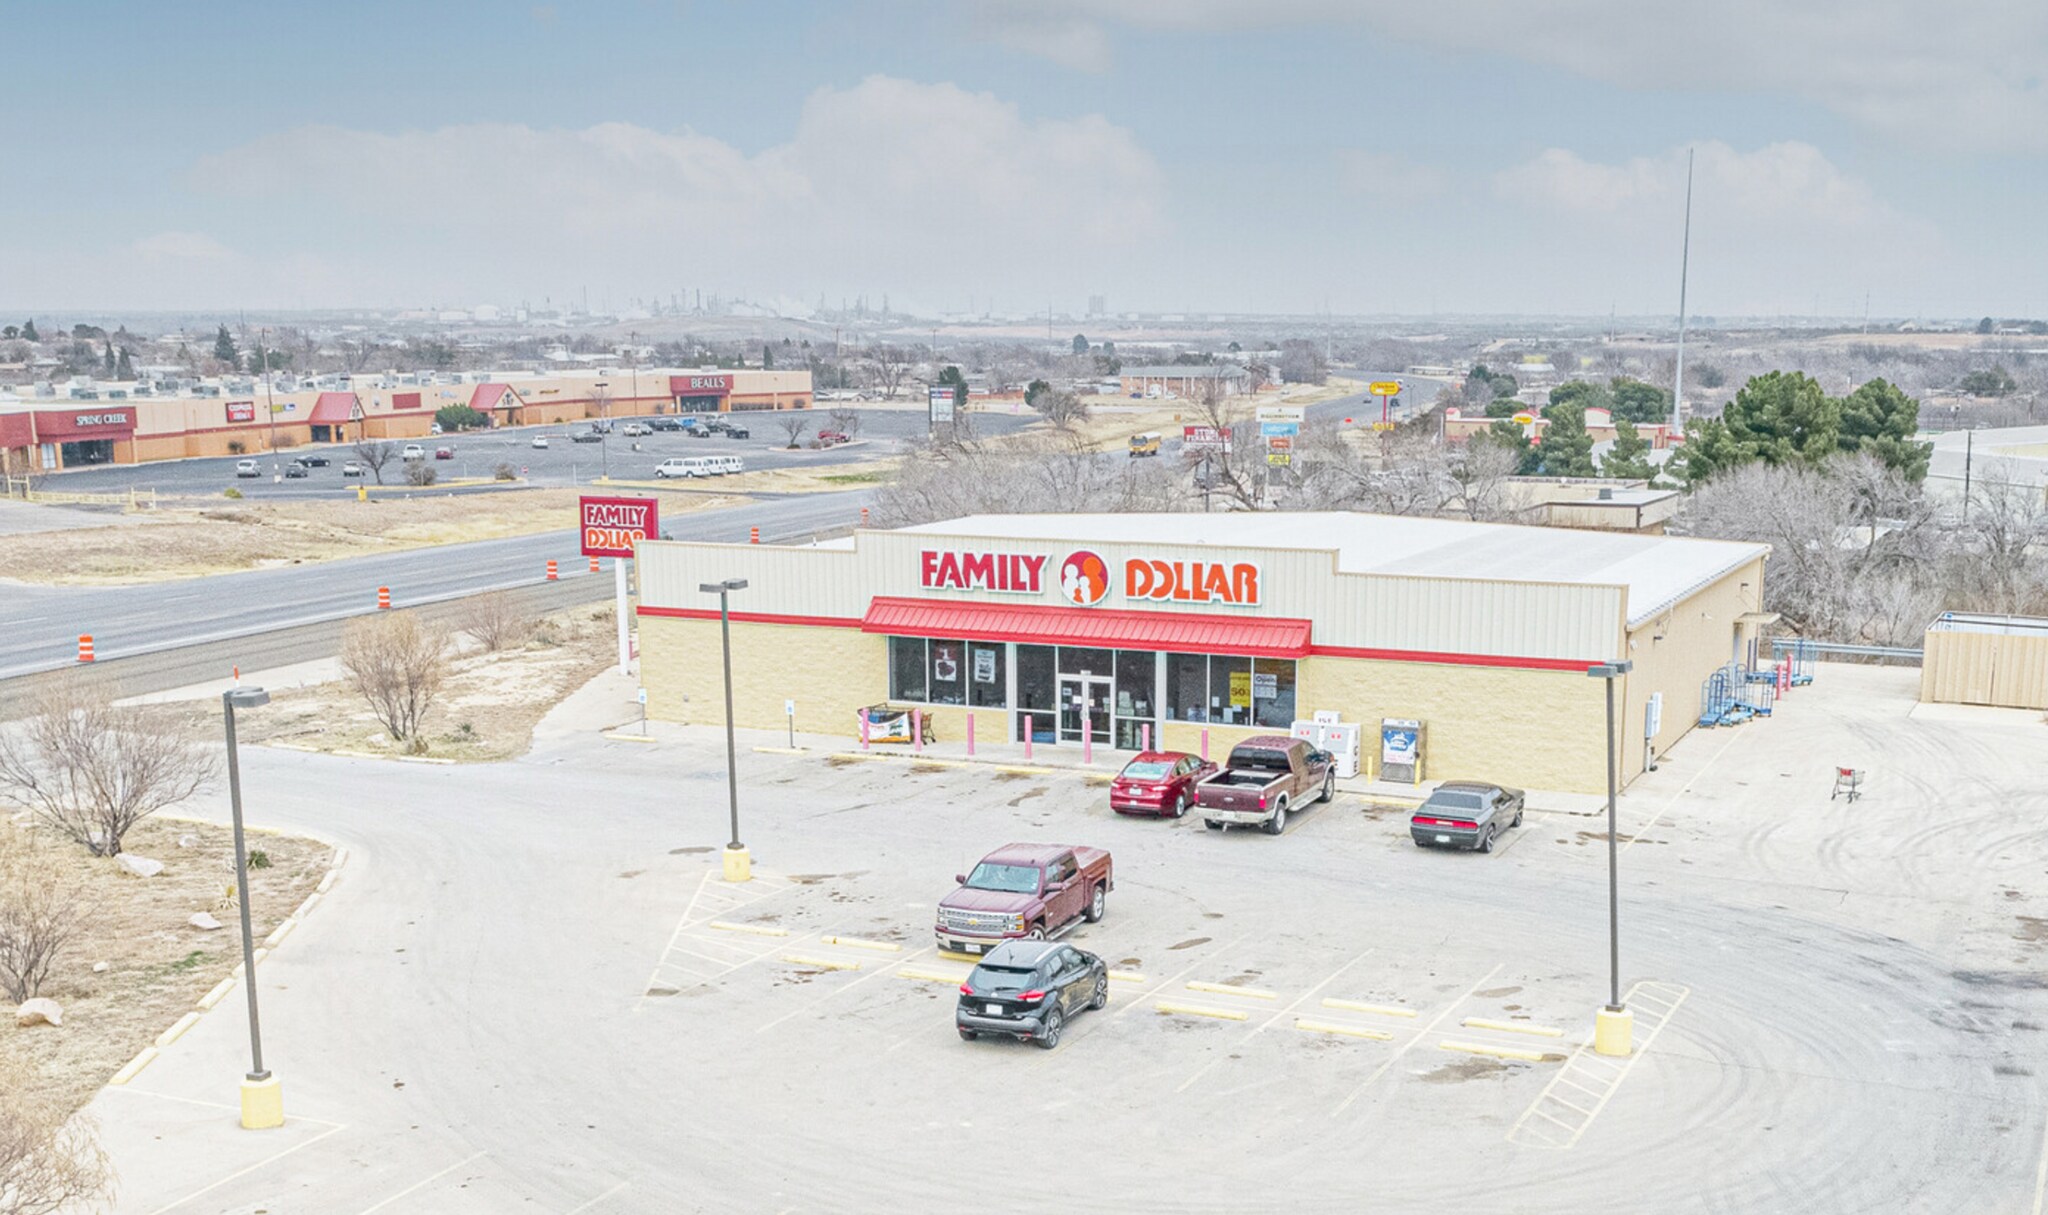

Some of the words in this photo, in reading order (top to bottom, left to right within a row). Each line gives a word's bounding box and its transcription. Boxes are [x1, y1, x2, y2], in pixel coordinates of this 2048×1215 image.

[691, 377, 725, 388] BEALLS
[76, 415, 103, 426] SPRING
[103, 413, 127, 424] CREEK
[585, 504, 647, 527] FAMILY
[921, 550, 1050, 594] FAMILY
[1125, 558, 1258, 604] DOLLAR
